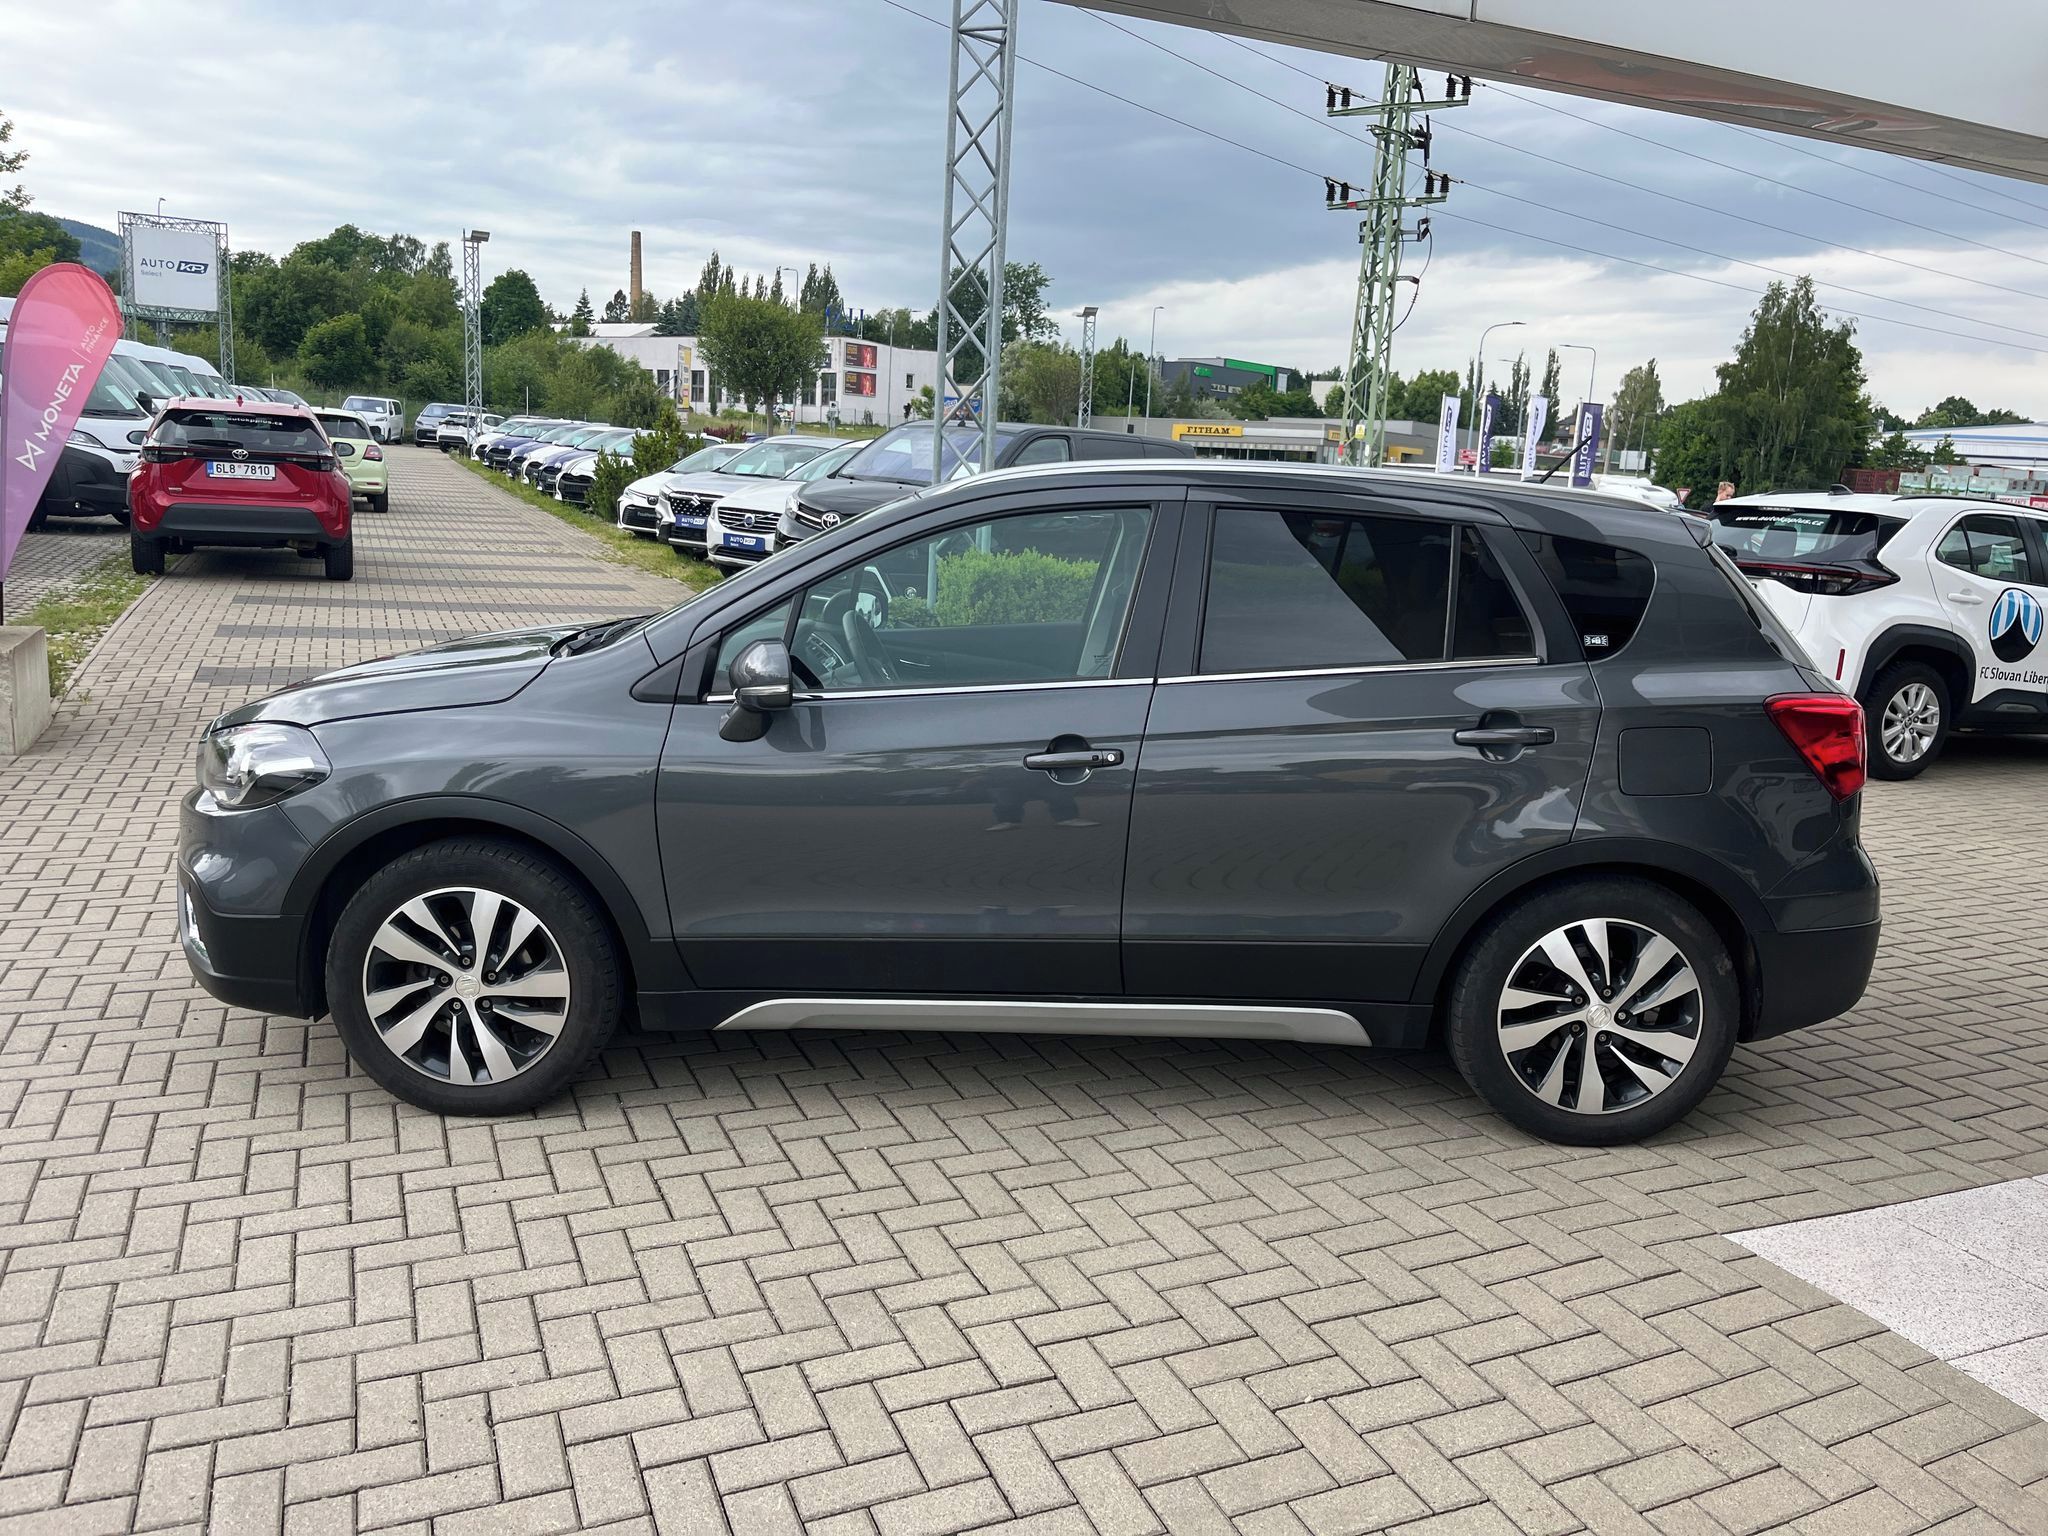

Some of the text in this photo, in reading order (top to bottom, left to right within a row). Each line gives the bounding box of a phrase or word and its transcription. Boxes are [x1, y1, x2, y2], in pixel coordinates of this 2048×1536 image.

[140, 258, 175, 270] AUTO
[85, 317, 110, 354] FINANCE
[34, 324, 97, 441] MONETA AUTO
[1186, 426, 1231, 435] FITHAM
[215, 463, 270, 476] 6L8 7810
[1578, 446, 1589, 478] AUTO
[1735, 515, 1824, 526] www.autokpplus.cz
[1980, 666, 2048, 685] FC Slovan Liber
